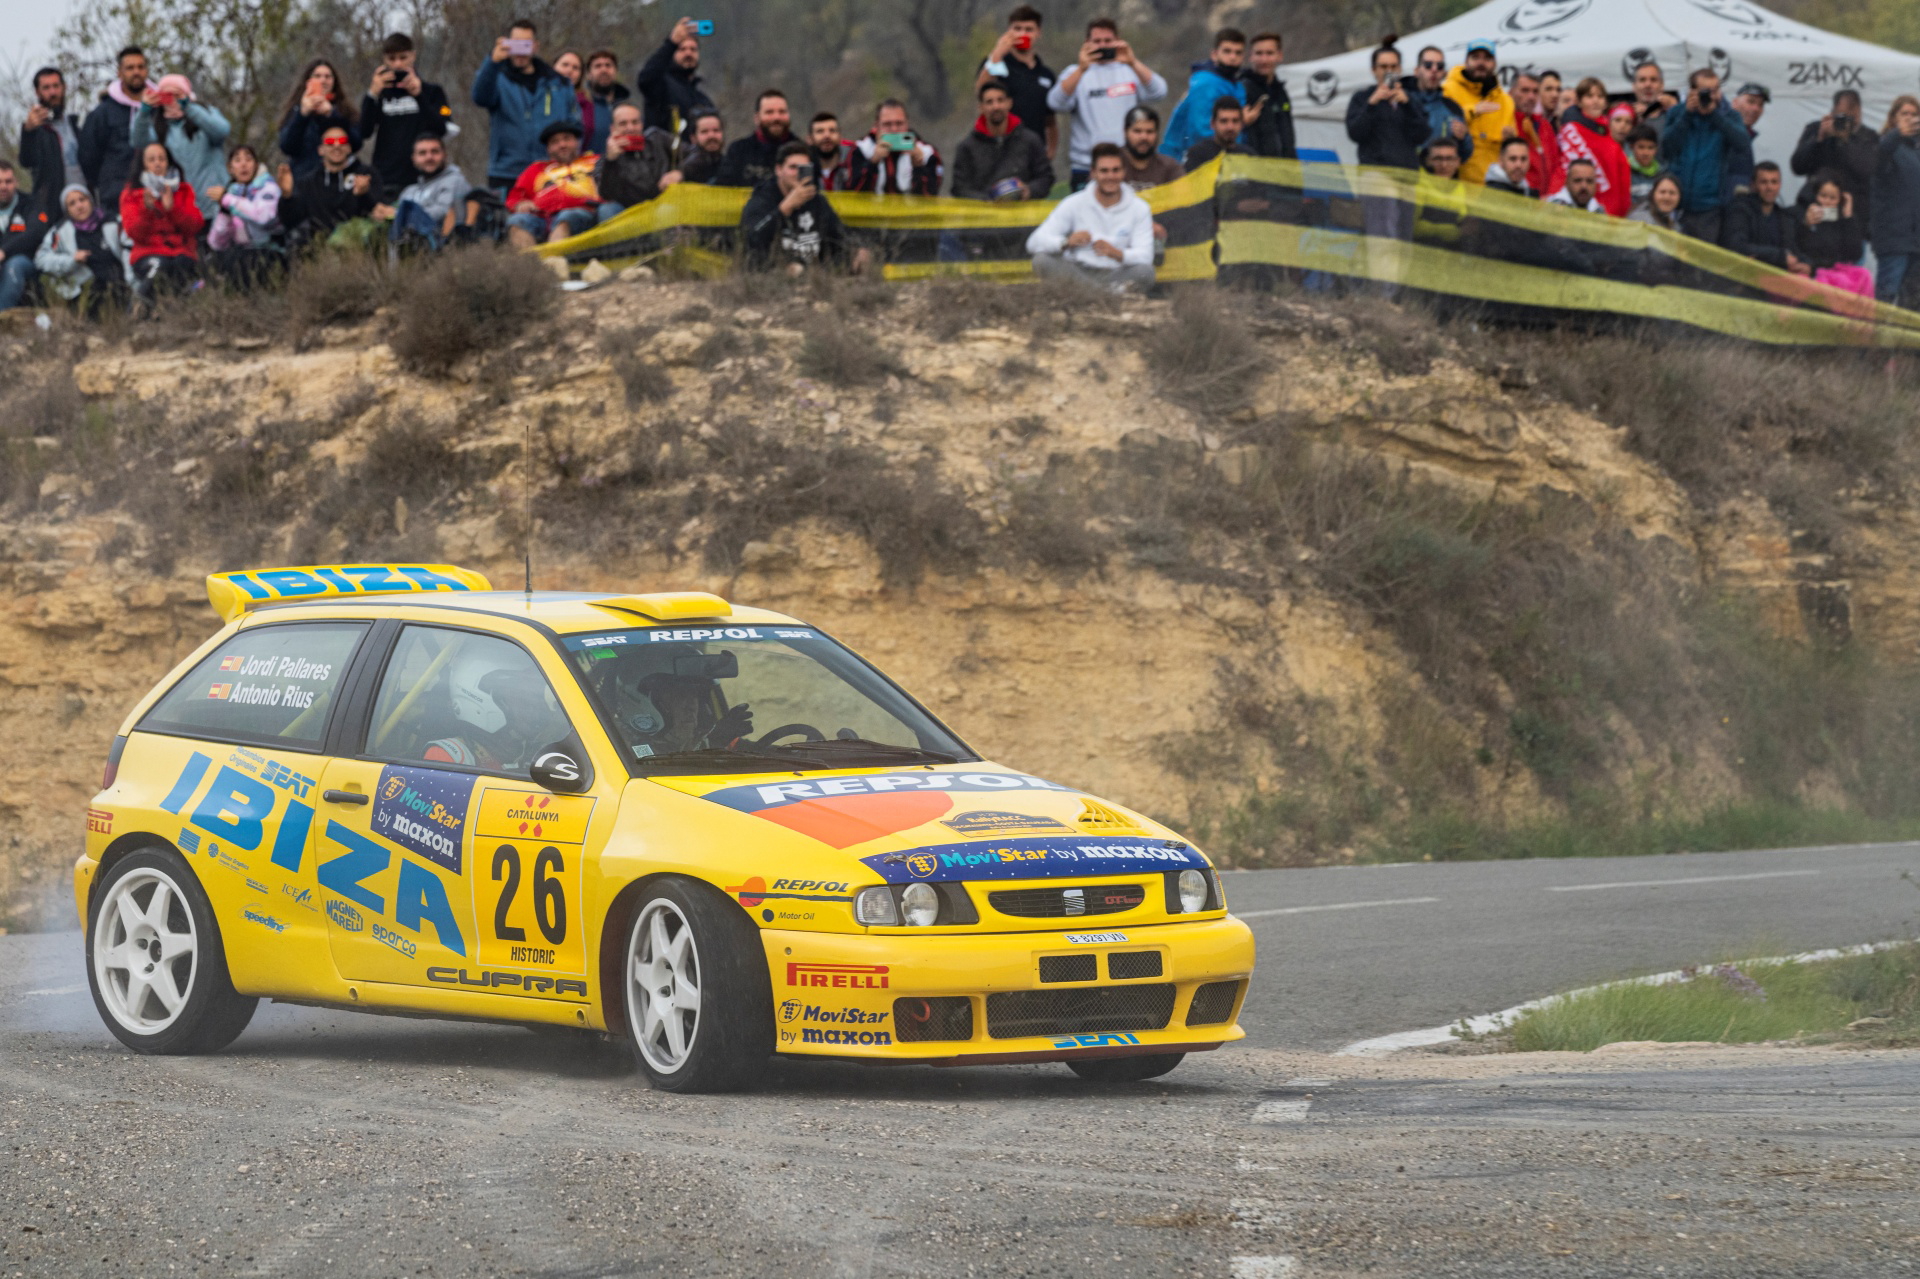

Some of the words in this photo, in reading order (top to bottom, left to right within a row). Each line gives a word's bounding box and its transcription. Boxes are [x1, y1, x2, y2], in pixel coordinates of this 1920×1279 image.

[227, 566, 471, 600] IBIZA
[581, 635, 627, 647] SEAT
[649, 628, 763, 642] REPSOL
[774, 630, 813, 639] SEAT
[240, 655, 279, 677] Jordi
[275, 656, 332, 681] Pallares
[228, 682, 281, 706] Antonio
[281, 685, 314, 709] Rius
[260, 759, 317, 799] SEAT
[756, 773, 1068, 805] REPSOL
[399, 786, 462, 830] MoviStar
[506, 808, 559, 823] CATALUNYA
[378, 808, 391, 828] by
[392, 813, 454, 858] maxon
[159, 750, 467, 958] IBIZA
[942, 848, 1049, 870] MoviStar
[1055, 846, 1079, 863] by
[1077, 844, 1190, 864] maxon
[491, 843, 567, 946] 26
[772, 878, 849, 893] REPSOL
[244, 909, 285, 933] speedline
[778, 912, 802, 920] Motor
[803, 912, 815, 920] Oil
[372, 923, 417, 955] sparco
[510, 946, 555, 965] HISTORIC
[427, 966, 587, 997] CUPRA
[786, 962, 890, 989] PIRELLI
[803, 1005, 889, 1024] MoviStar
[781, 1029, 796, 1044] by
[802, 1027, 892, 1046] maxon
